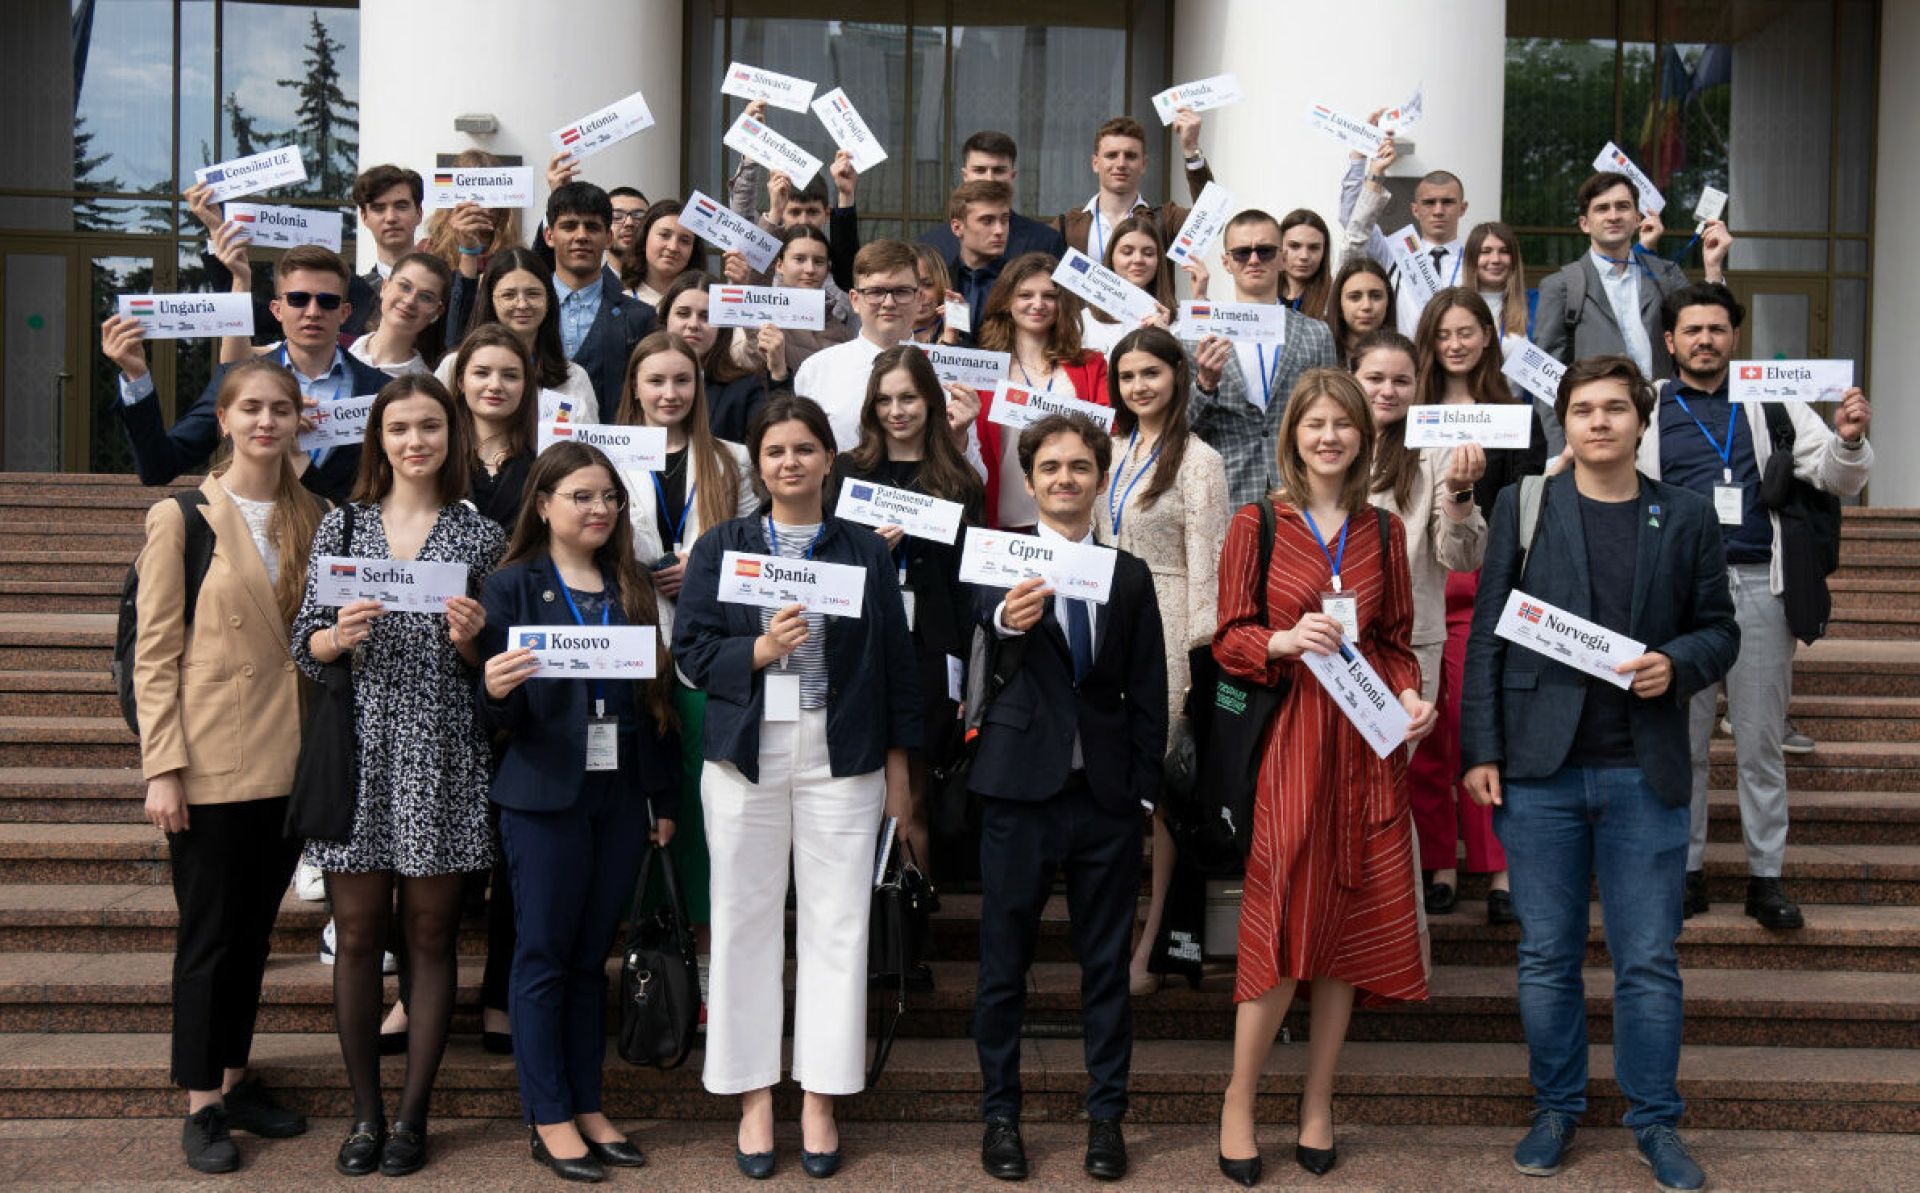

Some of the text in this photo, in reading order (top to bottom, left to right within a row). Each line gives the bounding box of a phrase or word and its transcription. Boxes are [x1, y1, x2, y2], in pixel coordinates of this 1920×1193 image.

[580, 110, 619, 137] Letonia
[759, 131, 808, 169] Azerbaijan
[225, 153, 290, 178] Consiliul UE
[456, 173, 513, 187] Germania
[260, 211, 308, 228] Polonia
[744, 230, 757, 242] de
[757, 237, 772, 252] Jos
[744, 288, 790, 306] Austria
[159, 300, 215, 316] Ungaria
[1212, 308, 1259, 322] Armenia
[931, 350, 999, 370] Danemarca
[1767, 367, 1812, 382] Elveția
[333, 404, 373, 421] Geor
[1443, 410, 1491, 424] Islanda
[577, 430, 630, 446] Monaco
[875, 497, 919, 516] European
[876, 487, 934, 508] Parlamentul
[1008, 539, 1054, 562] Cipru
[362, 567, 414, 585] Serbia
[763, 563, 816, 585] Spania
[551, 633, 609, 649] Kosovo
[1545, 613, 1611, 653] Norvegia
[1348, 661, 1387, 712] Estonia
